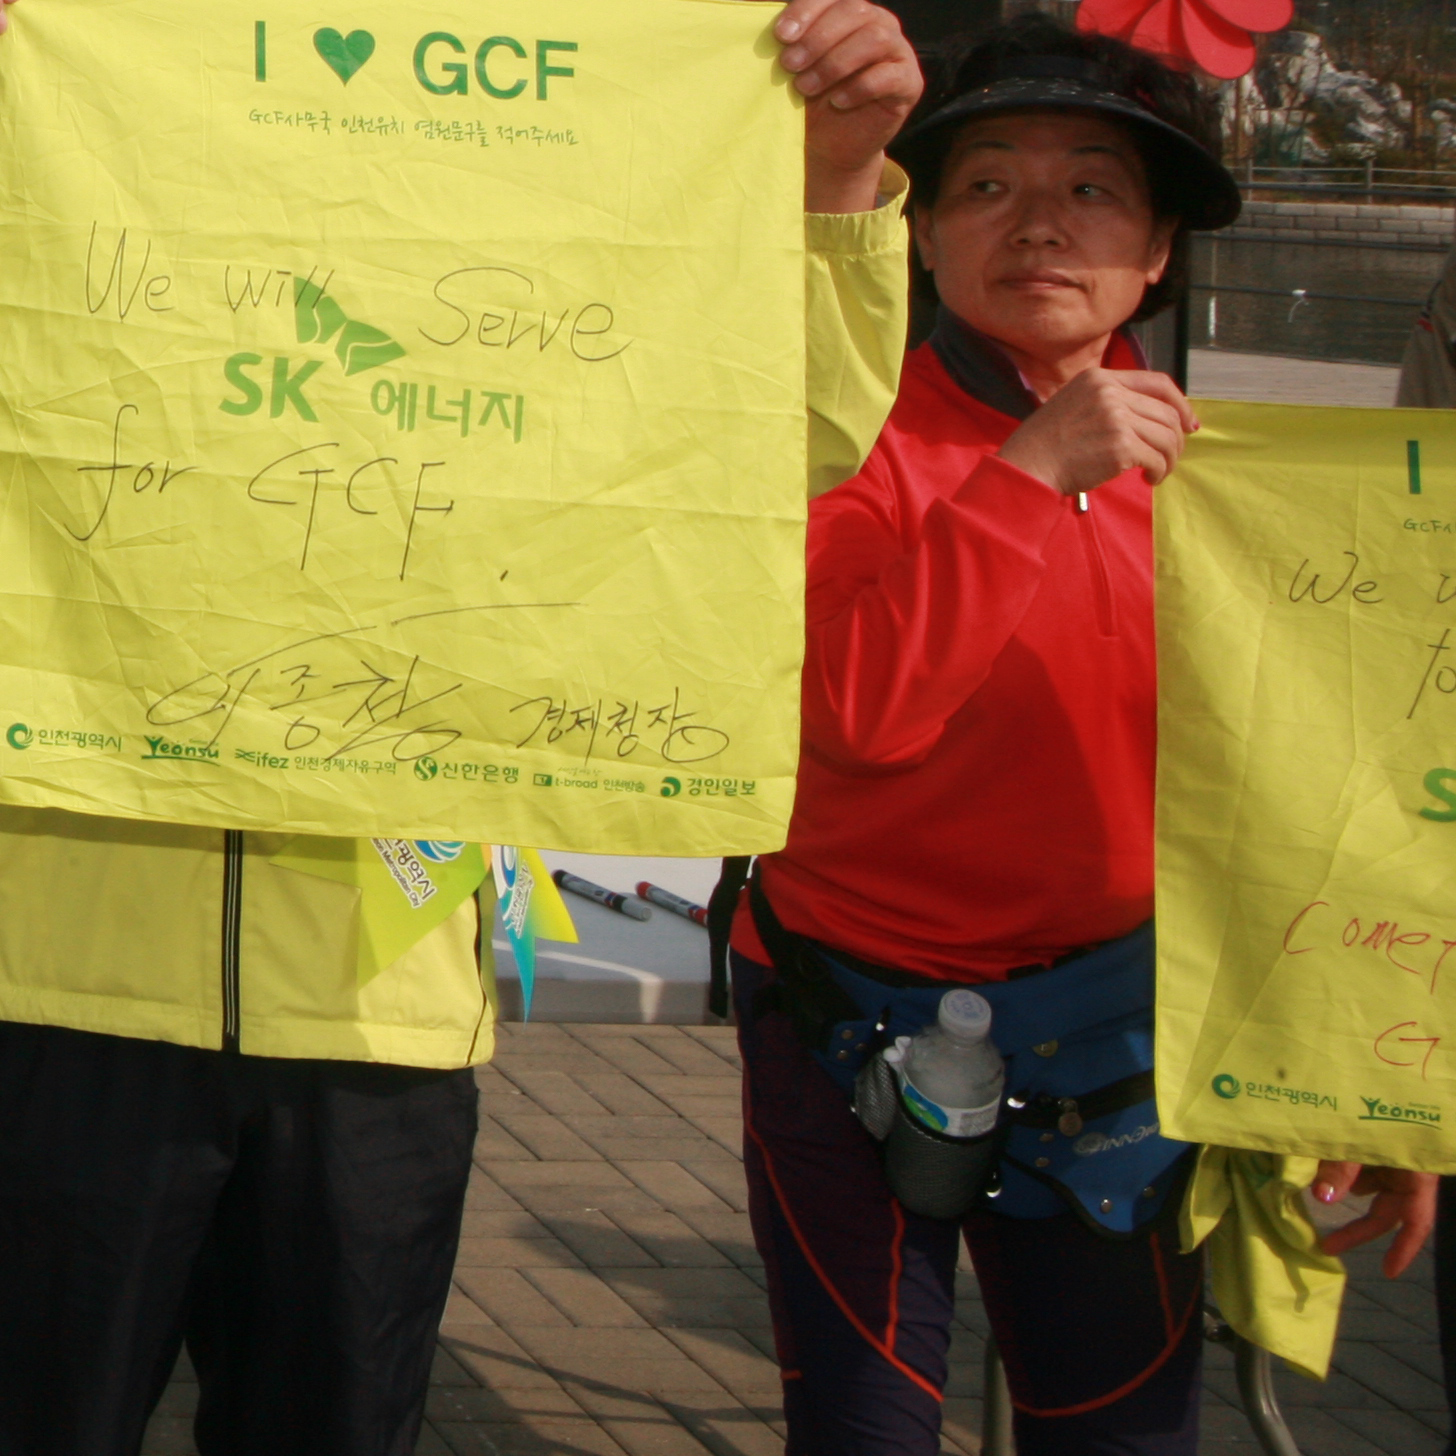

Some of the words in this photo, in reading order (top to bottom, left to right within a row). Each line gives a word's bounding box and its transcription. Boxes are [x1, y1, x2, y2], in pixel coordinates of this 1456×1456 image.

[255, 20, 267, 82] I
[412, 31, 579, 101] GCF
[248, 108, 331, 135] GCF사무국
[341, 116, 405, 136] 인천유치
[414, 119, 489, 147] 염원문구를
[496, 125, 580, 146] 적어주세요
[85, 220, 175, 324] We
[224, 264, 328, 313] will
[417, 265, 635, 361] Serve
[218, 351, 325, 423] SK
[369, 377, 525, 443] 에너지
[65, 403, 198, 541] for
[1406, 440, 1421, 495] I
[1288, 551, 1385, 607] We
[38, 729, 122, 752] 인천광역시
[143, 735, 220, 760] Yeonsu
[256, 751, 288, 769] ifez
[294, 756, 397, 775] 인천경제자유구역
[441, 762, 519, 784] 신한은행
[555, 777, 598, 790] t-broad
[603, 779, 645, 793] 인천방송
[687, 777, 757, 796] 경인일보
[1245, 1081, 1337, 1111] 인천광역시
[1359, 1095, 1441, 1123] Yeonsu
